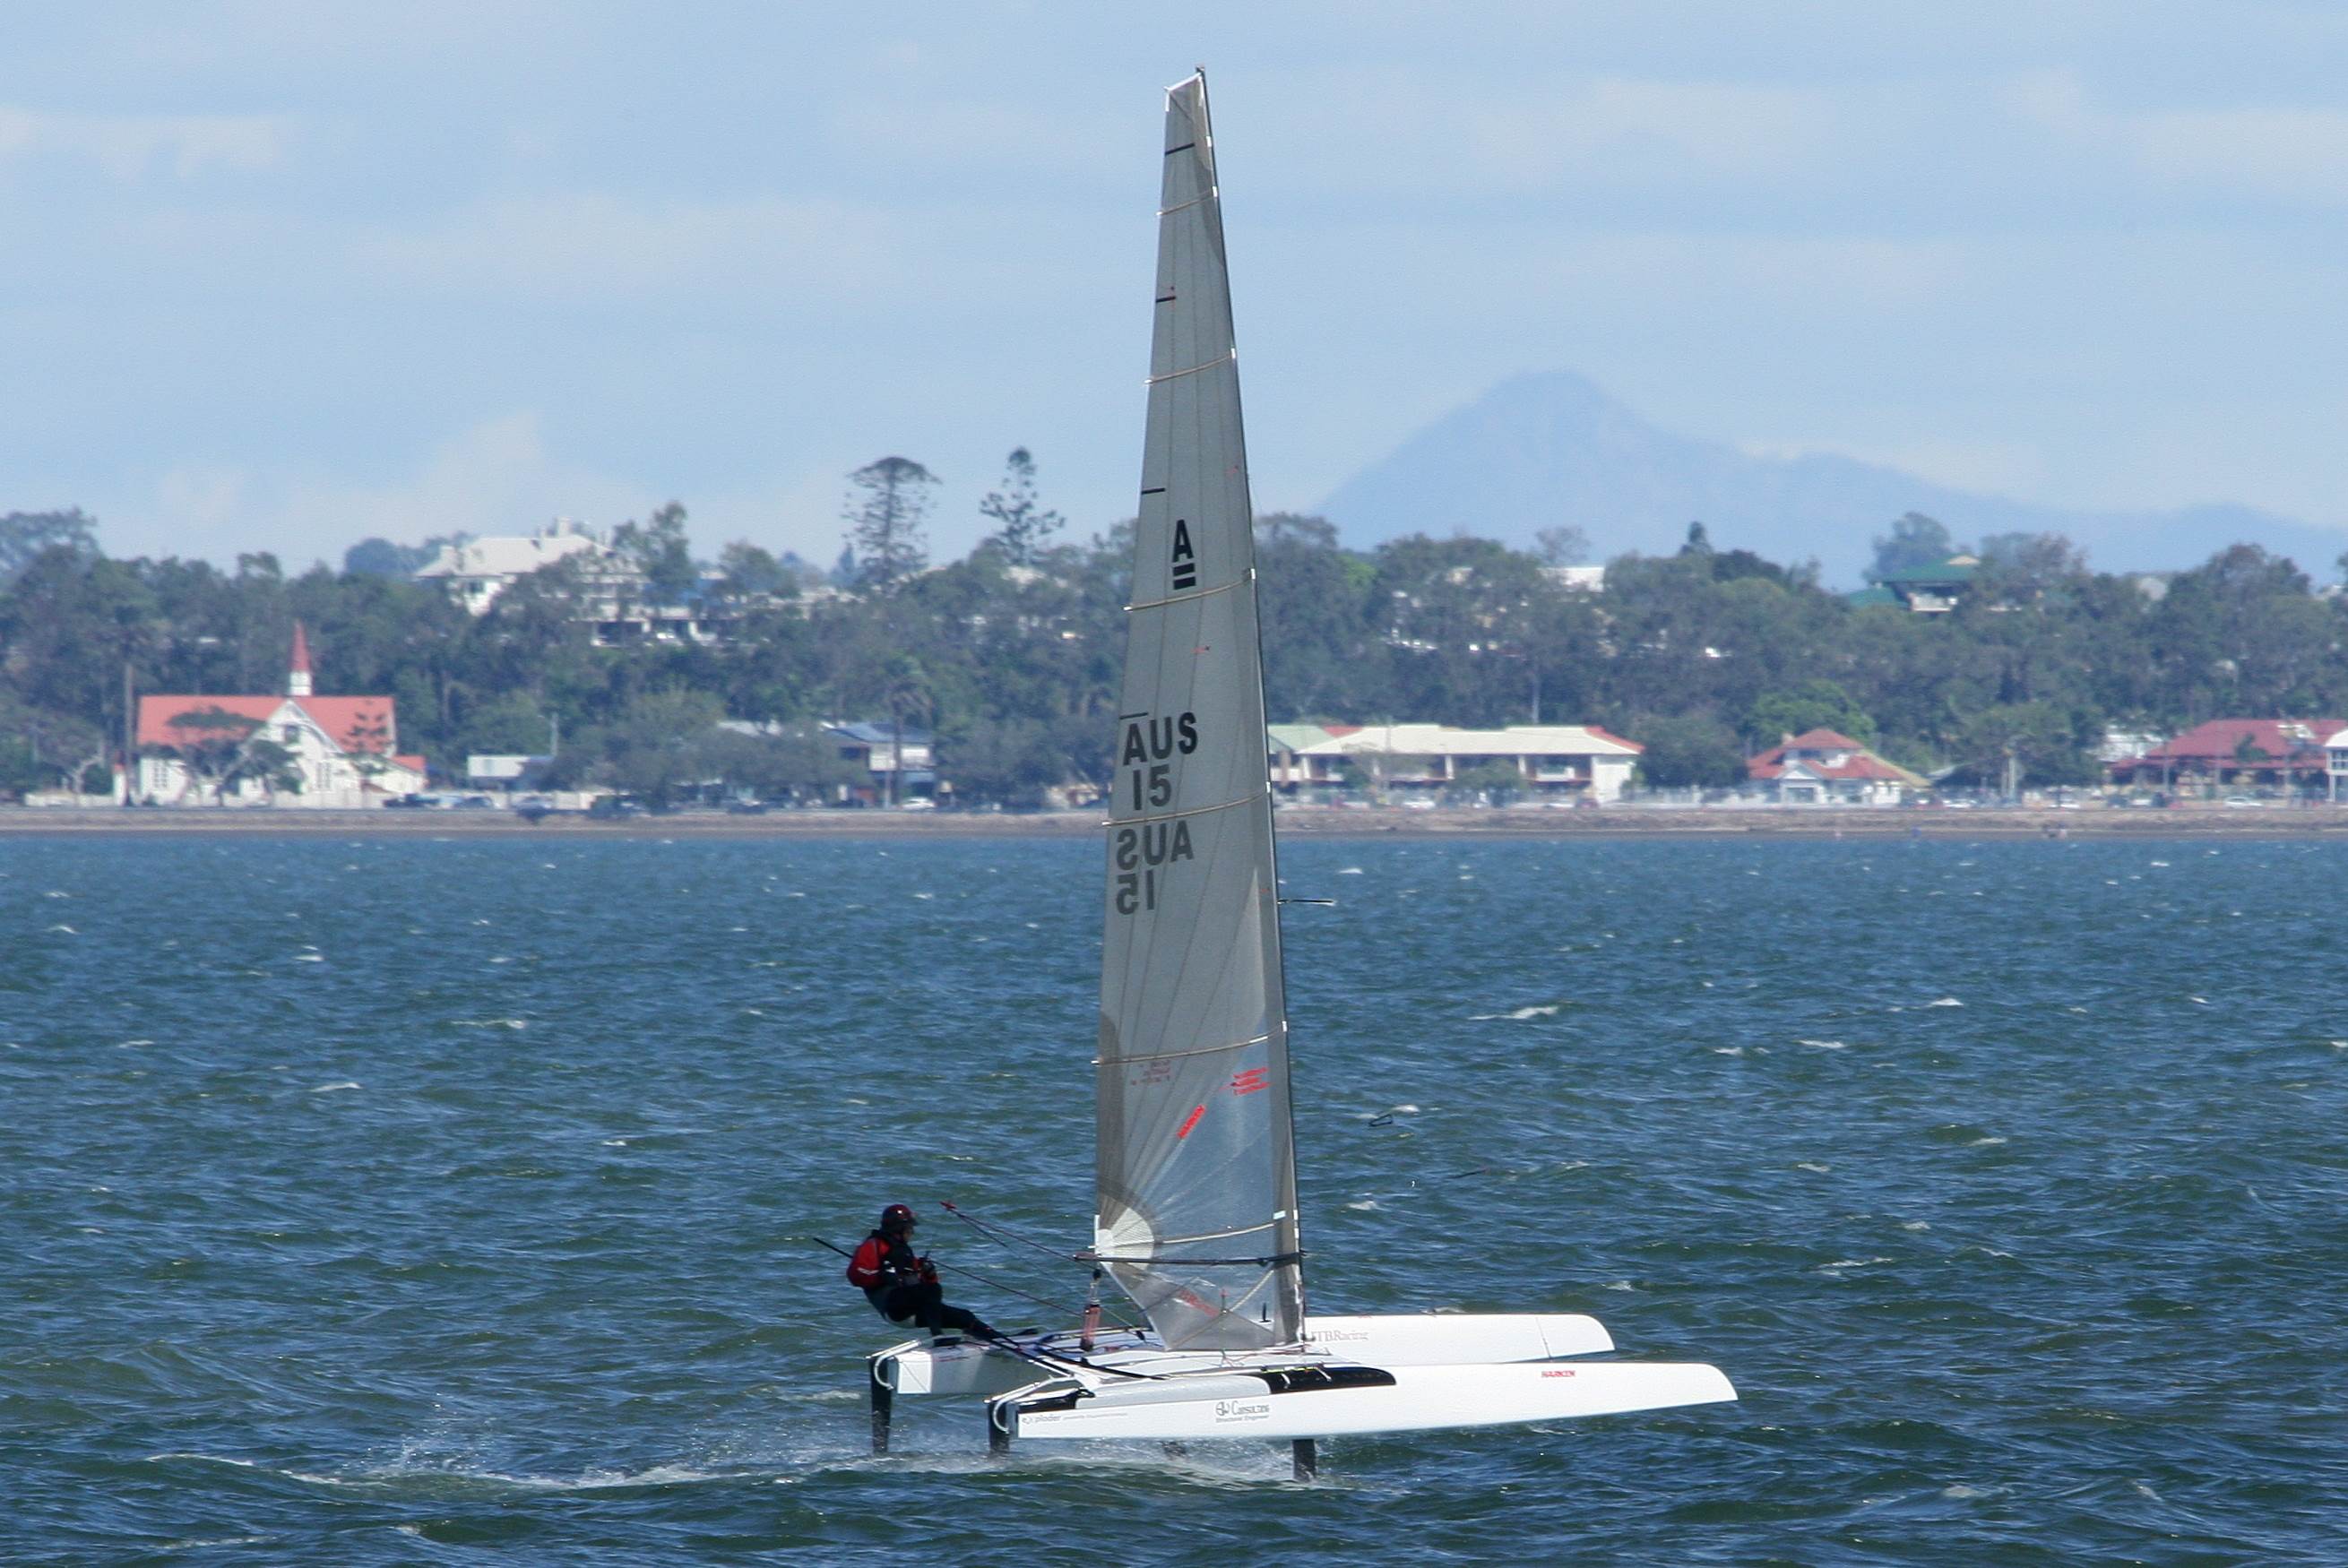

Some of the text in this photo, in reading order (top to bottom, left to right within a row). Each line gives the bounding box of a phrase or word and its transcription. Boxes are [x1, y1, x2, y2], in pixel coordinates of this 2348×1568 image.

[1172, 519, 1194, 563] A
[1122, 711, 1198, 766] AUS
[1132, 763, 1172, 811] 15
